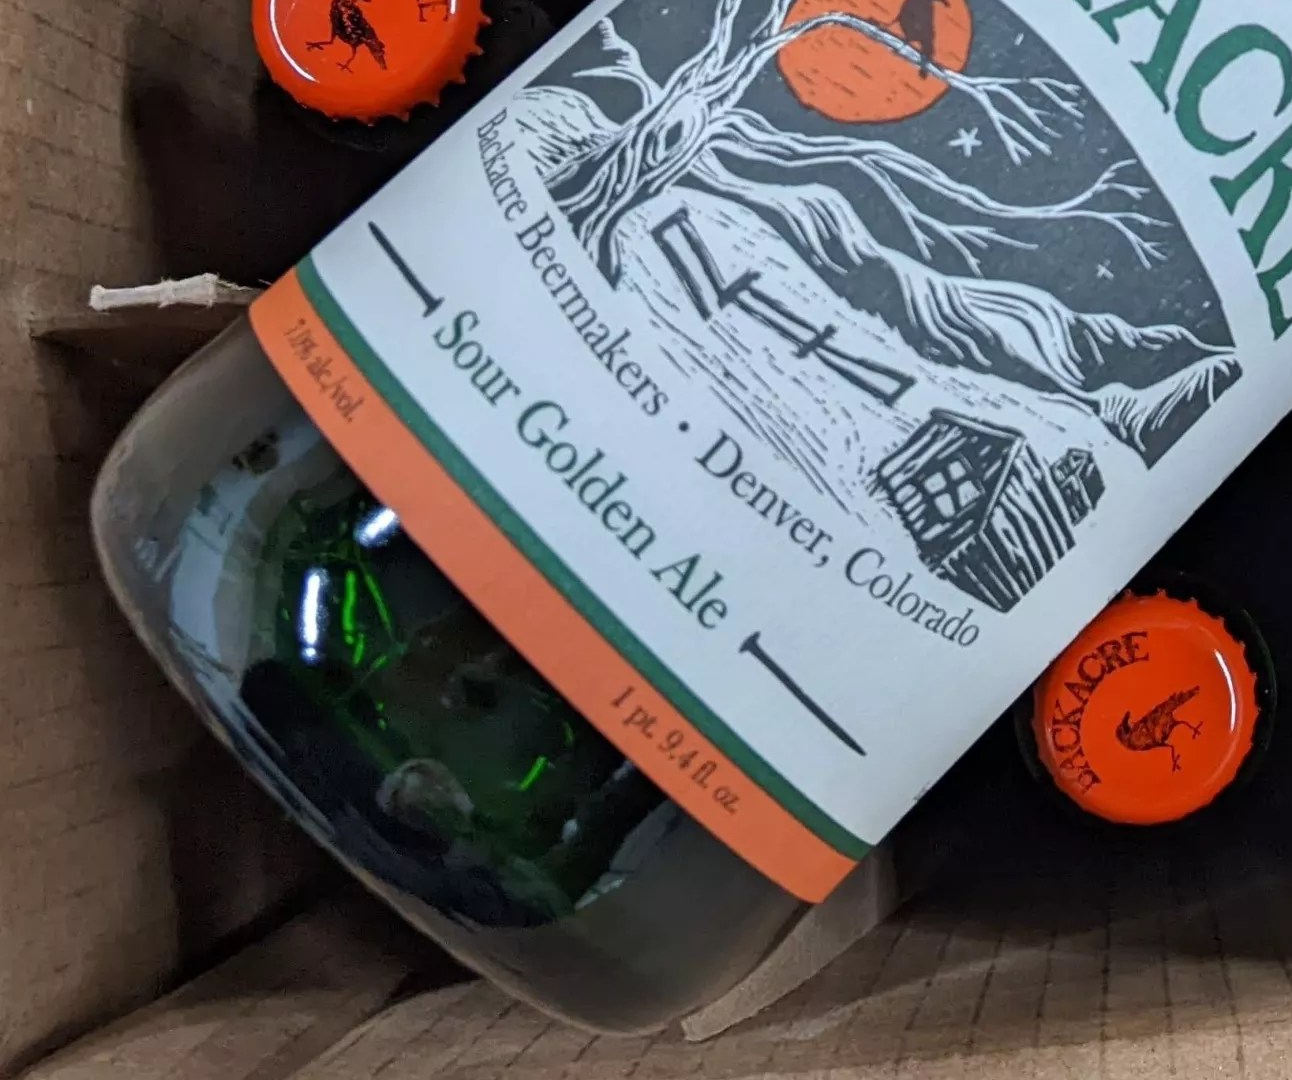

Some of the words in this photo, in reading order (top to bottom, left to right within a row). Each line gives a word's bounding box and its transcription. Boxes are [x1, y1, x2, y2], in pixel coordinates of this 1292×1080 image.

[432, 309, 522, 407] Sour
[517, 400, 657, 561] Golden
[650, 553, 729, 630] Ale
[477, 107, 528, 222] Backacre
[515, 212, 669, 416] Beermakers
[694, 428, 833, 568] Denver,
[845, 547, 980, 647] Colorado
[611, 685, 635, 708] 1
[1052, 631, 1150, 795] BACKACRE
